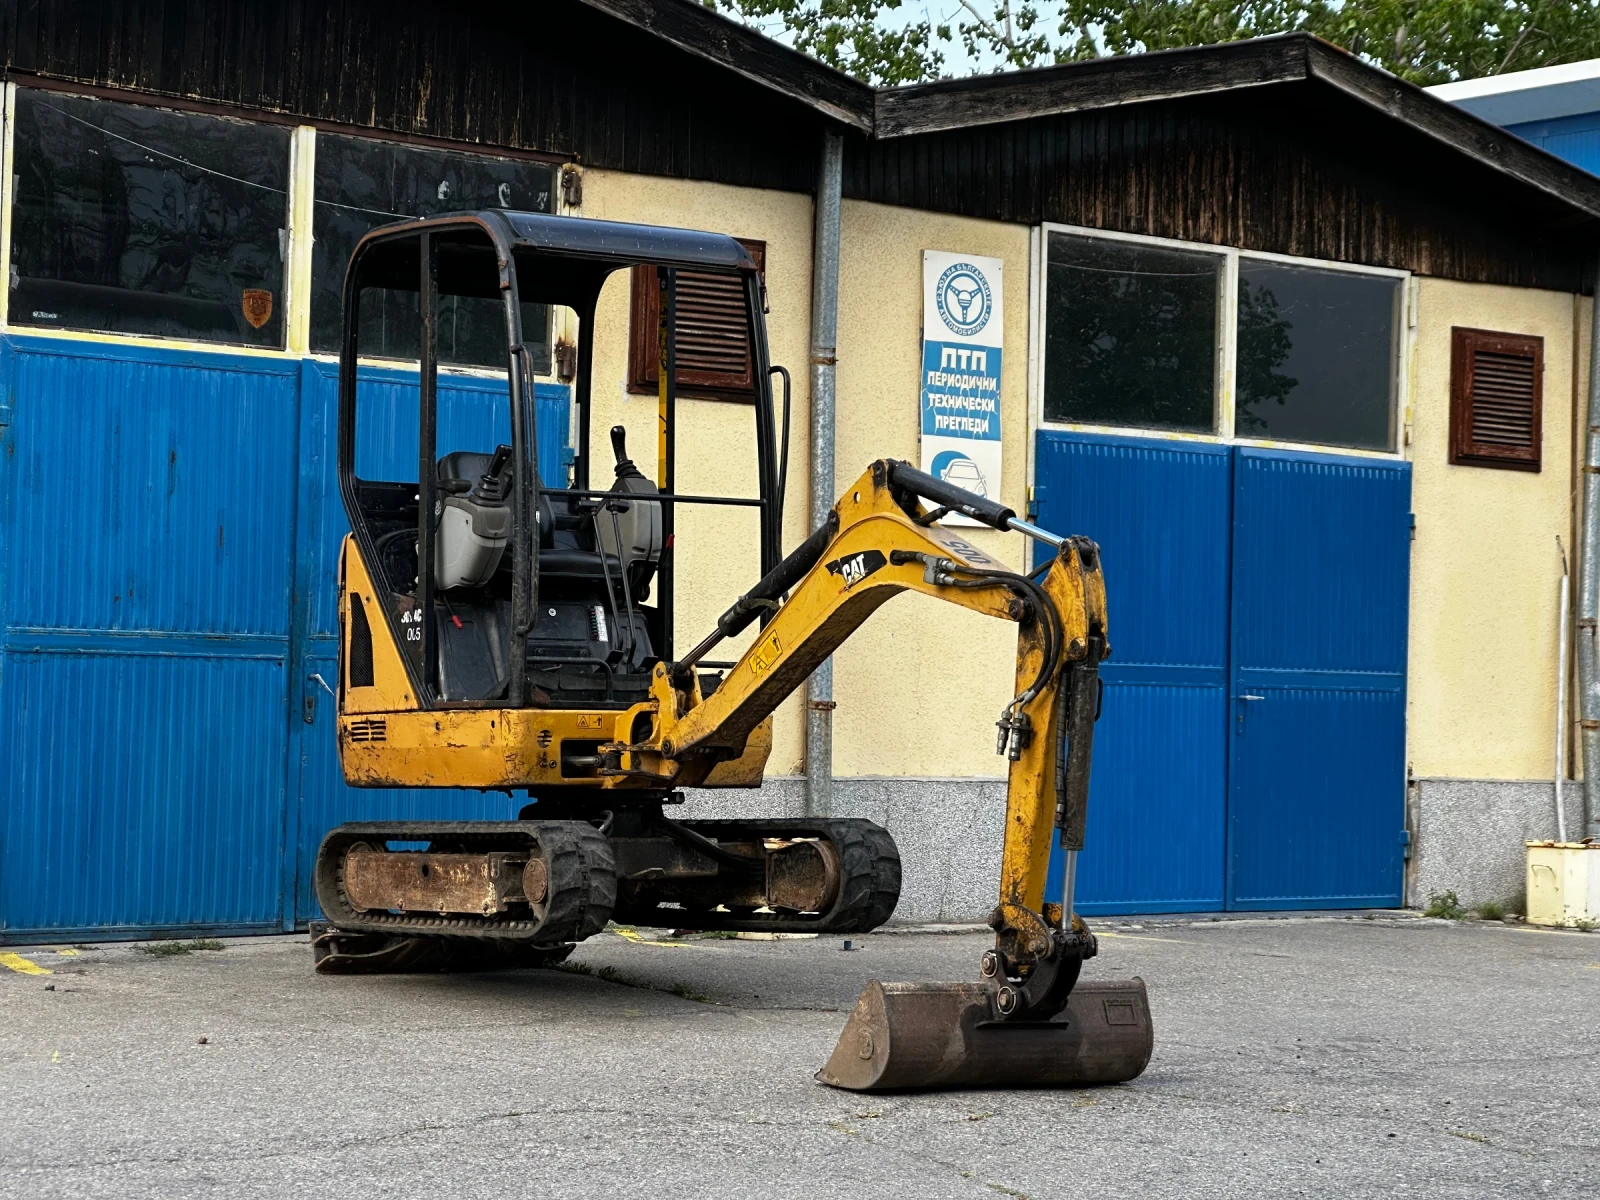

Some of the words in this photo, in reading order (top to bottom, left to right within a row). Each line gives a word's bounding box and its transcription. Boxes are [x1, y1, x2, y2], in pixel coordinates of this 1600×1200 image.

[937, 276, 947, 301] СЪЮЗ
[946, 266, 956, 276] НА
[939, 308, 989, 336] АВТОМОБИЛИСТИ
[941, 347, 987, 371] ПТП
[927, 370, 997, 391] ПЕРИОДИЧНИ
[928, 393, 995, 412] ТЕХНИЧЕСКИ
[935, 414, 989, 433] ПРЕГЛЕДИ
[842, 553, 865, 583] CAT
